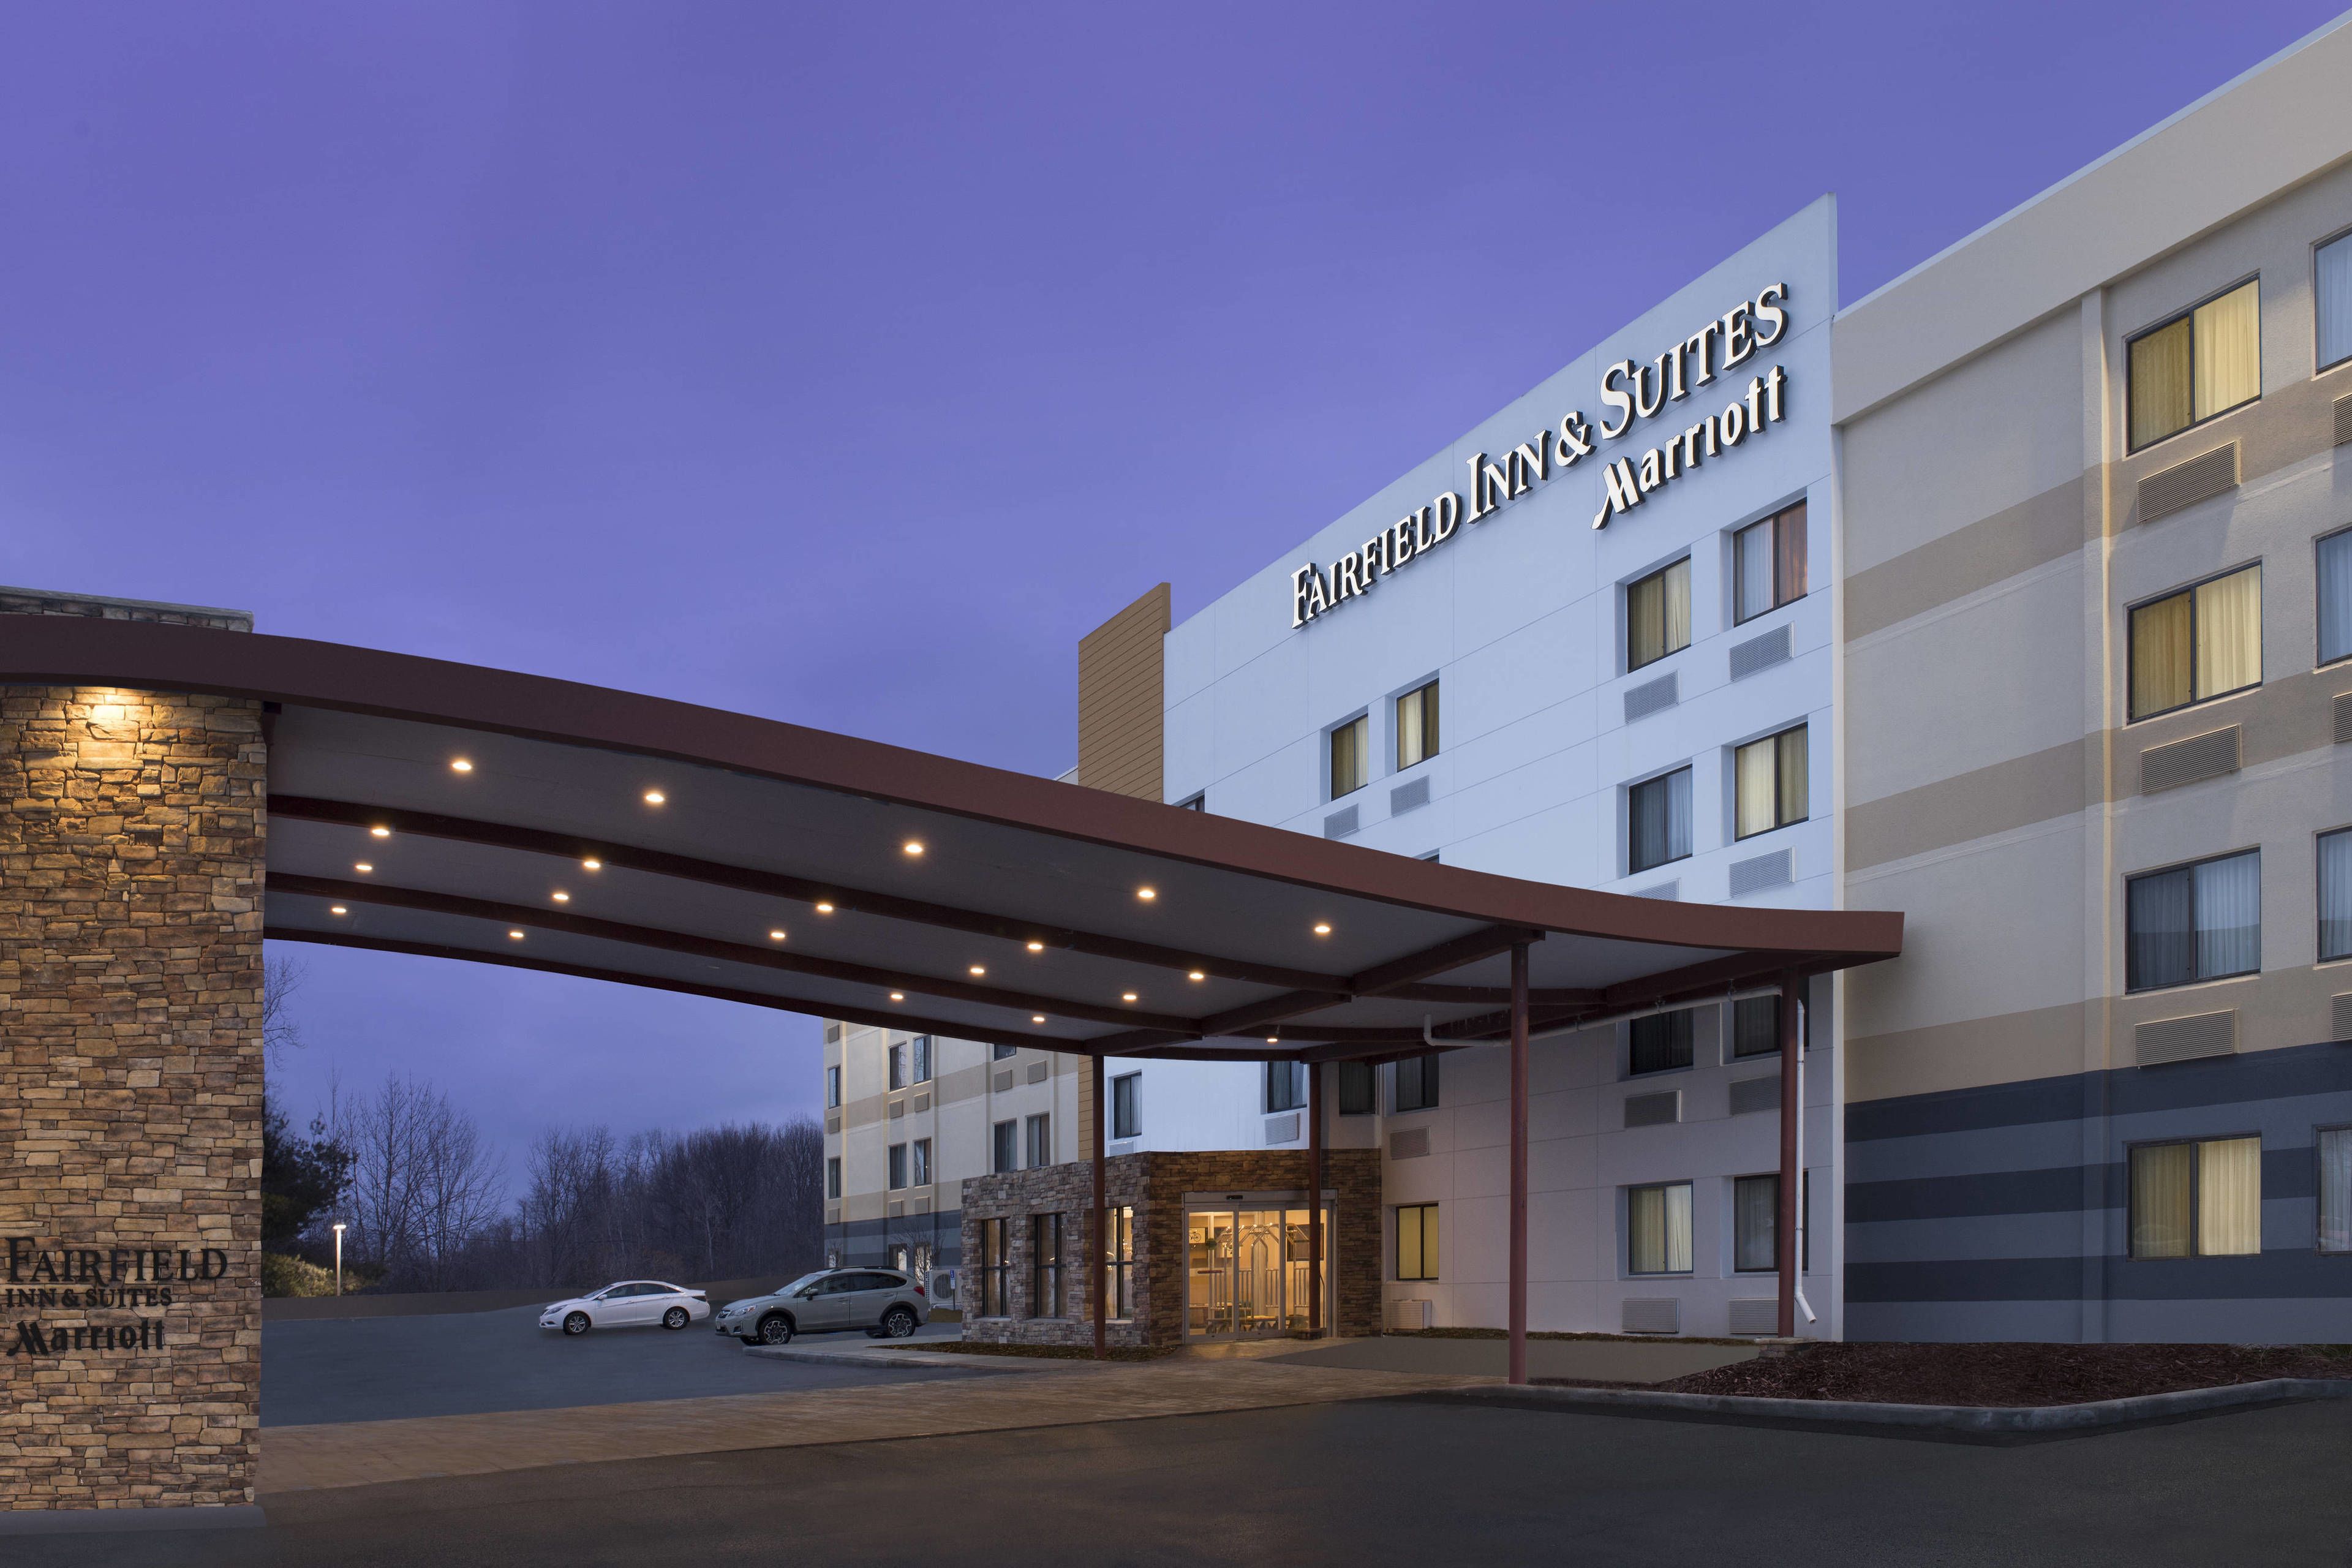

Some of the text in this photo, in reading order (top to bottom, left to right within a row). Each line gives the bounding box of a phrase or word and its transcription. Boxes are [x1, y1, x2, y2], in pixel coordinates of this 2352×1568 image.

[1290, 282, 1789, 629] FAIRFIELD INN & SUITES
[1591, 365, 1788, 530] Marriott
[6, 1237, 228, 1287] FAIRFIELD
[6, 1287, 173, 1308] INN & SUITES
[6, 1319, 165, 1357] Marriott
